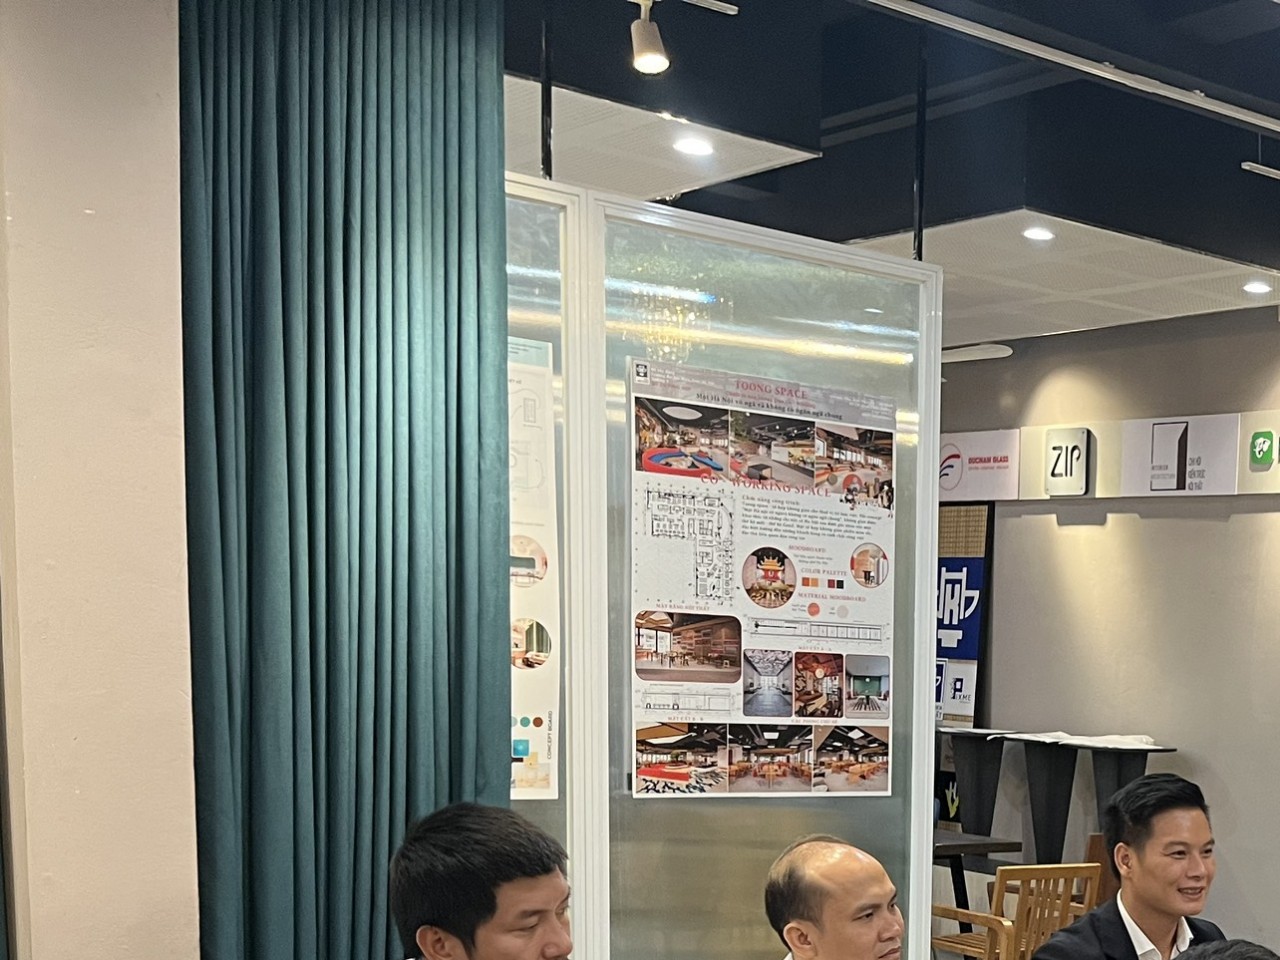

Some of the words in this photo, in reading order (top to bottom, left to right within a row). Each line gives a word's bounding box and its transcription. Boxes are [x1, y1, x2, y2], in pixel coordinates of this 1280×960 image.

[735, 380, 773, 395] TOONG
[774, 386, 808, 400] SPACE
[1050, 444, 1082, 478] ZIP
[732, 479, 791, 493] WORKING
[794, 486, 832, 498] SPACE
[801, 567, 821, 575] COLOR
[822, 569, 847, 577] PALETTE
